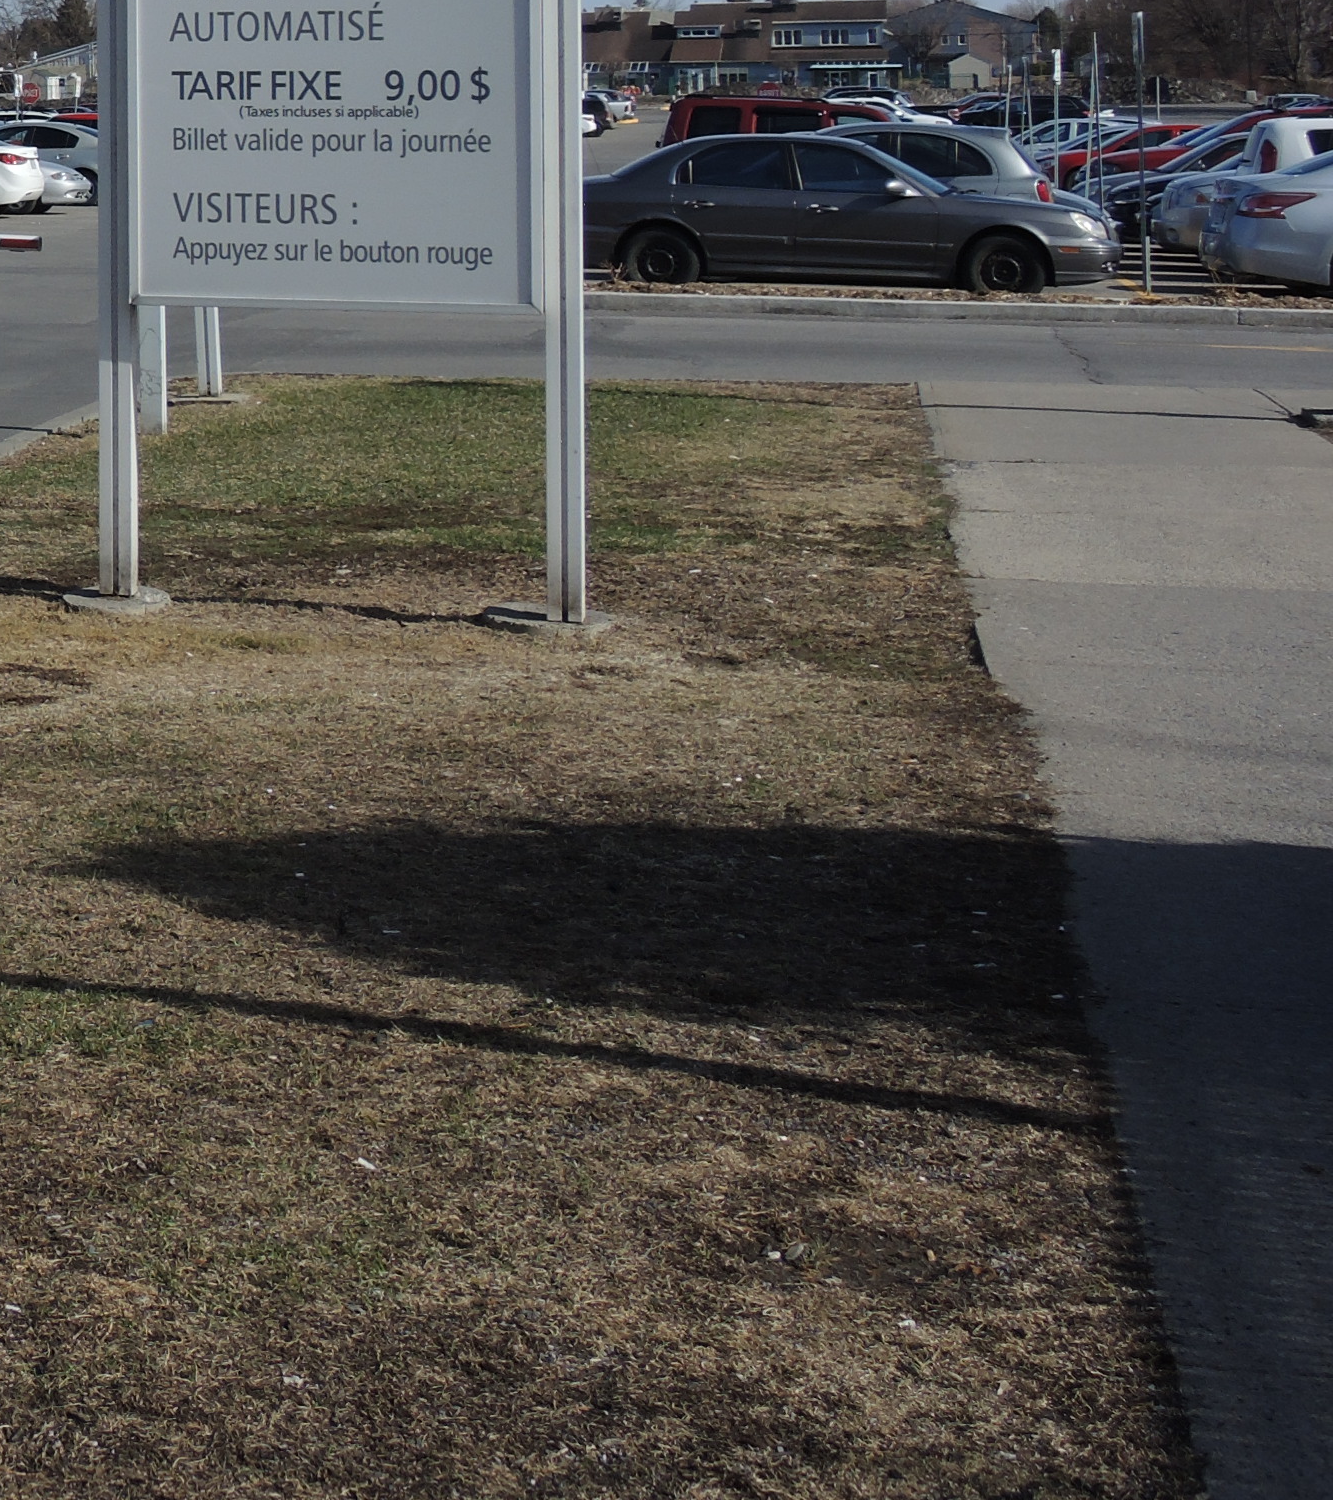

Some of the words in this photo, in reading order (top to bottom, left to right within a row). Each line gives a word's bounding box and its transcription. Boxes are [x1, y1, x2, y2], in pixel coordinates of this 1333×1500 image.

[170, 2, 384, 41] AUTOMATISÉ
[172, 71, 261, 100] TARIF
[272, 71, 342, 100] FIXE
[385, 70, 460, 106] 9,00
[471, 66, 490, 104] $
[239, 106, 279, 119] (Taxes
[283, 105, 331, 117] incluses
[335, 105, 344, 117] si
[347, 104, 419, 120] applicable)
[173, 128, 227, 151] Billet
[235, 128, 303, 151] valide
[313, 134, 366, 157] pour
[374, 129, 392, 152] la
[400, 128, 491, 158] journée
[173, 193, 337, 225] VISITEURS
[173, 237, 268, 266] Appuyez
[274, 244, 308, 261] sur
[315, 239, 332, 262] le
[340, 239, 419, 263] bouton
[428, 247, 492, 271] rouge
